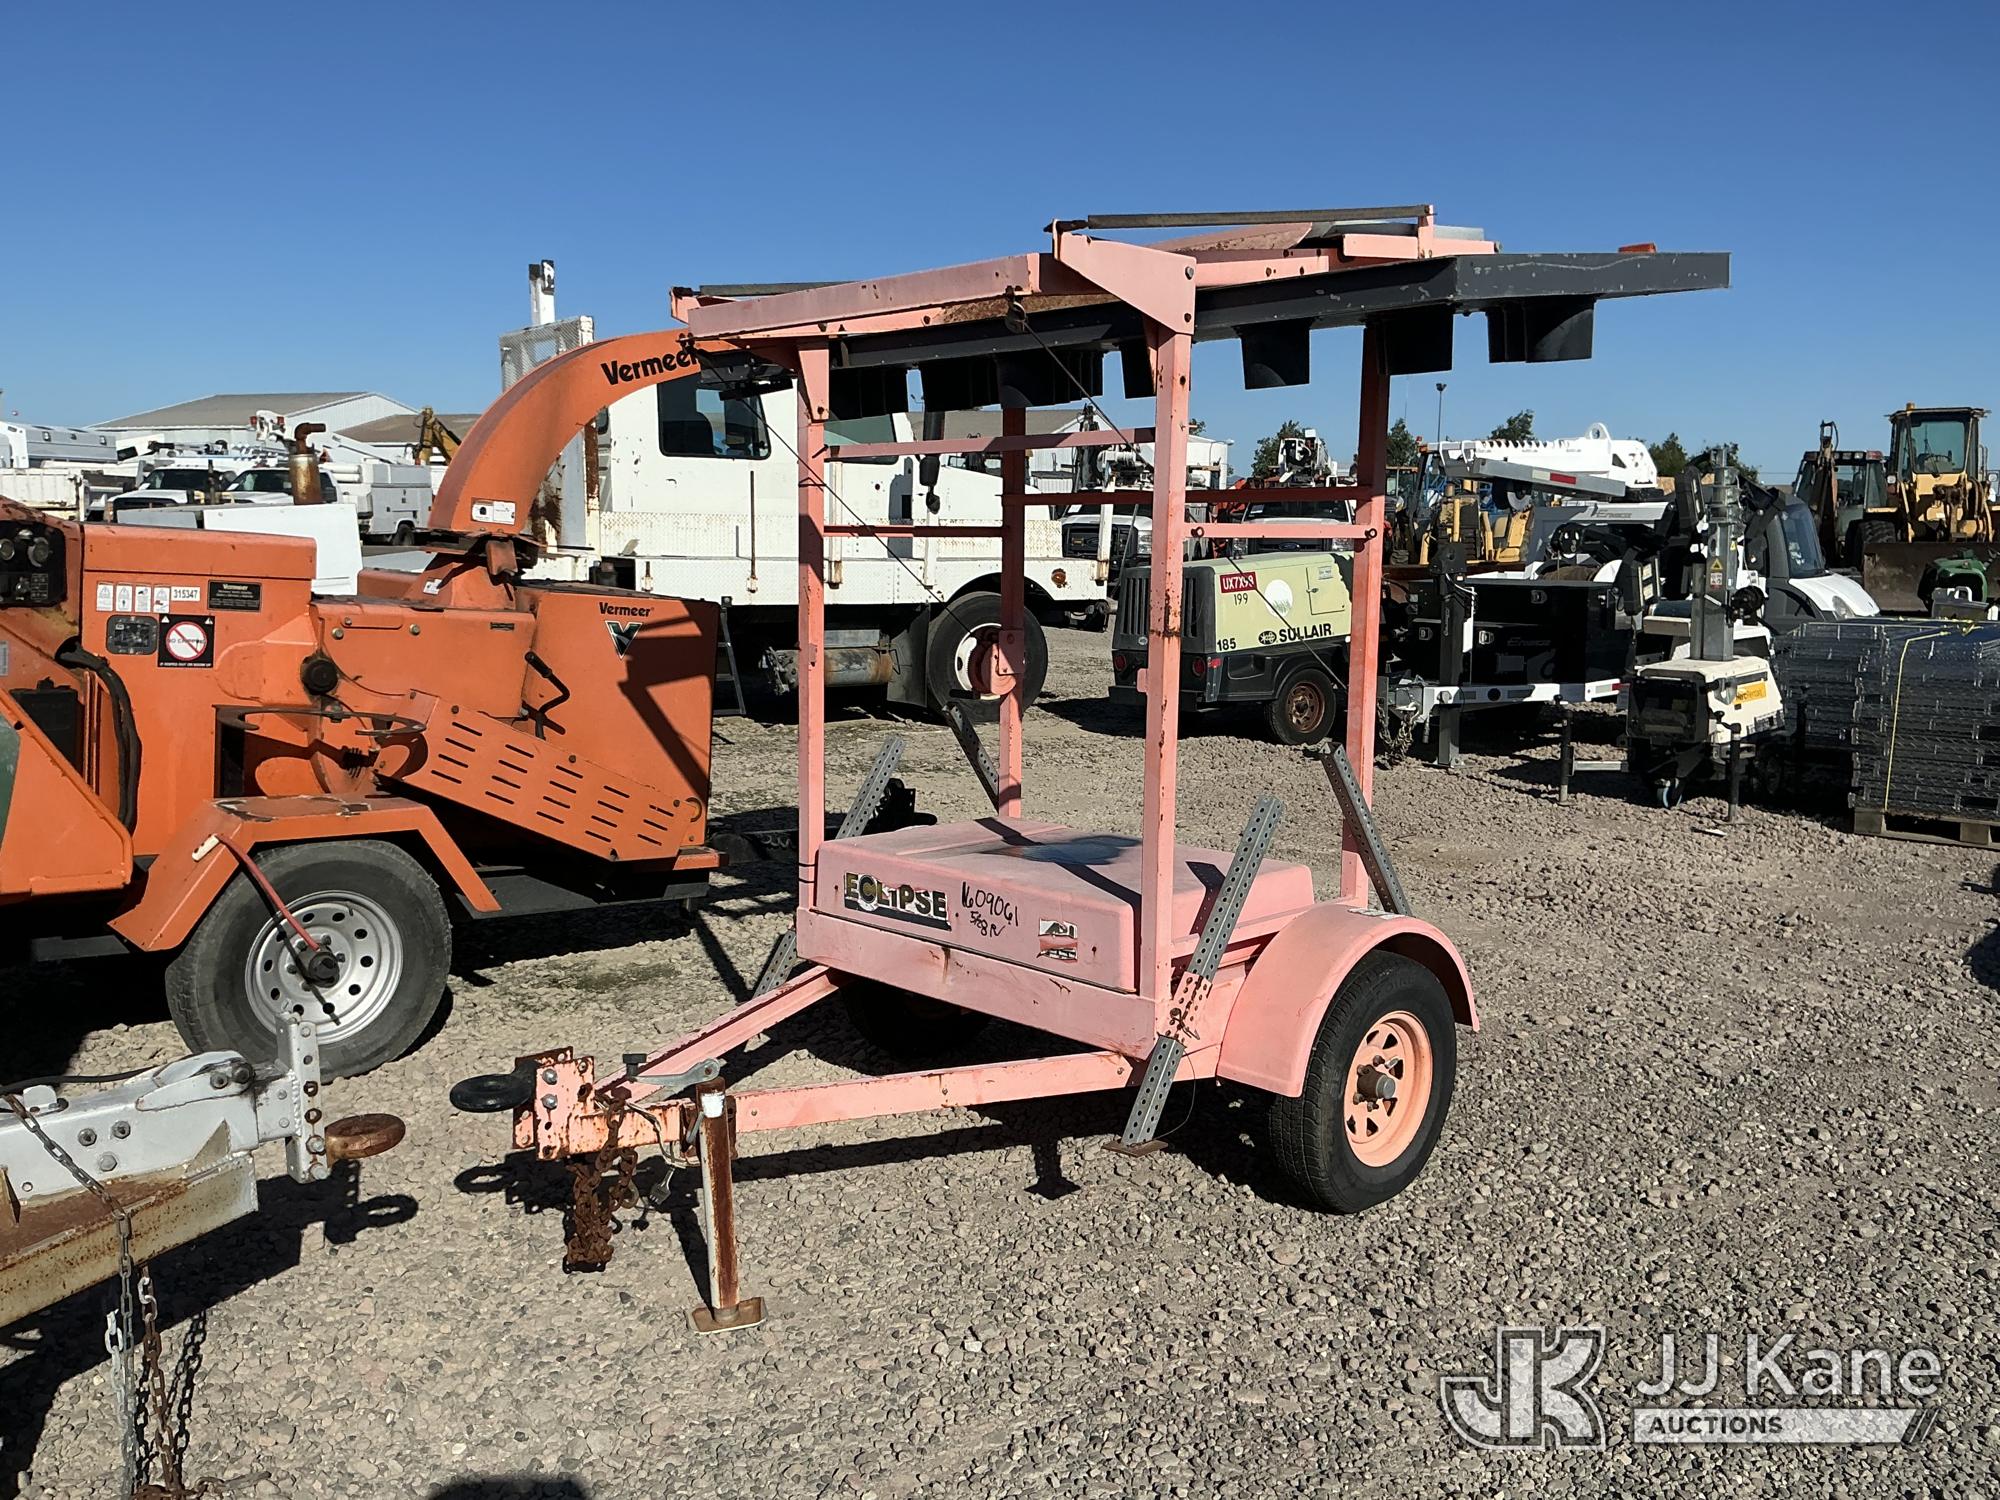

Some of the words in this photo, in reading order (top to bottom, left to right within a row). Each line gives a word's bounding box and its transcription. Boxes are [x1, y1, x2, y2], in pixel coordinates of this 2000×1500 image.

[173, 588, 199, 599] 315347
[1233, 592, 1249, 606] 199
[598, 601, 651, 617] Vermeer
[1279, 623, 1332, 642] SULLAIR
[1217, 637, 1237, 651] 185
